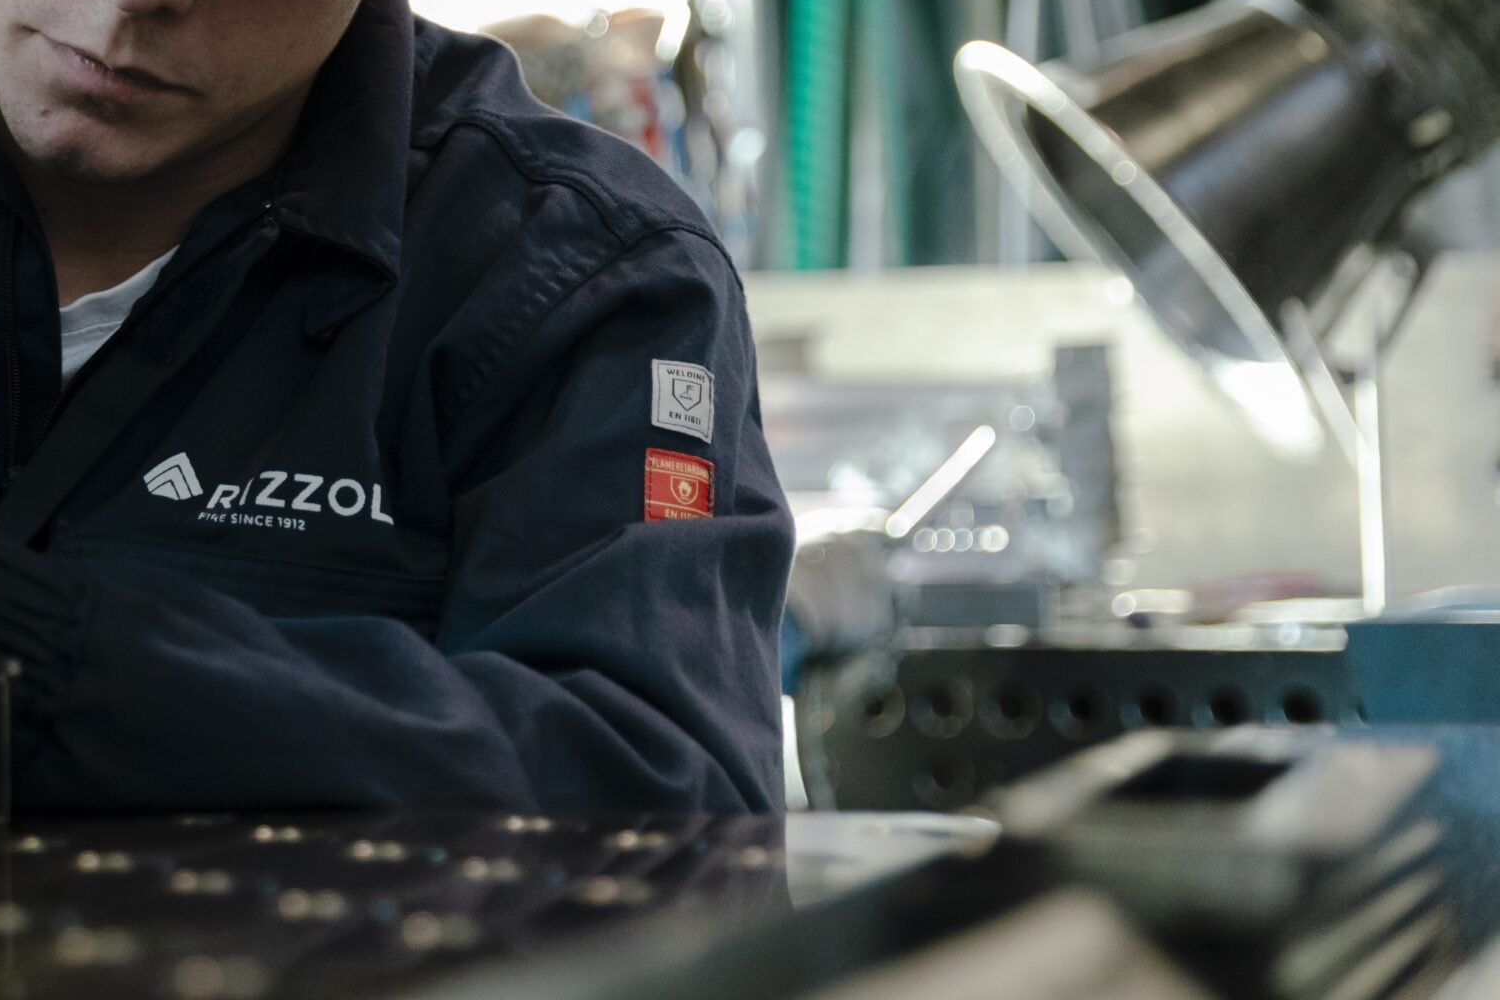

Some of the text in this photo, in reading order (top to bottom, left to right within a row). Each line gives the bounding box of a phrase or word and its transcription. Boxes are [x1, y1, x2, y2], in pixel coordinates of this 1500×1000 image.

[669, 410, 702, 426] EN 11611
[197, 511, 307, 532] FIRE SINCE 1912
[664, 508, 678, 519] EN
